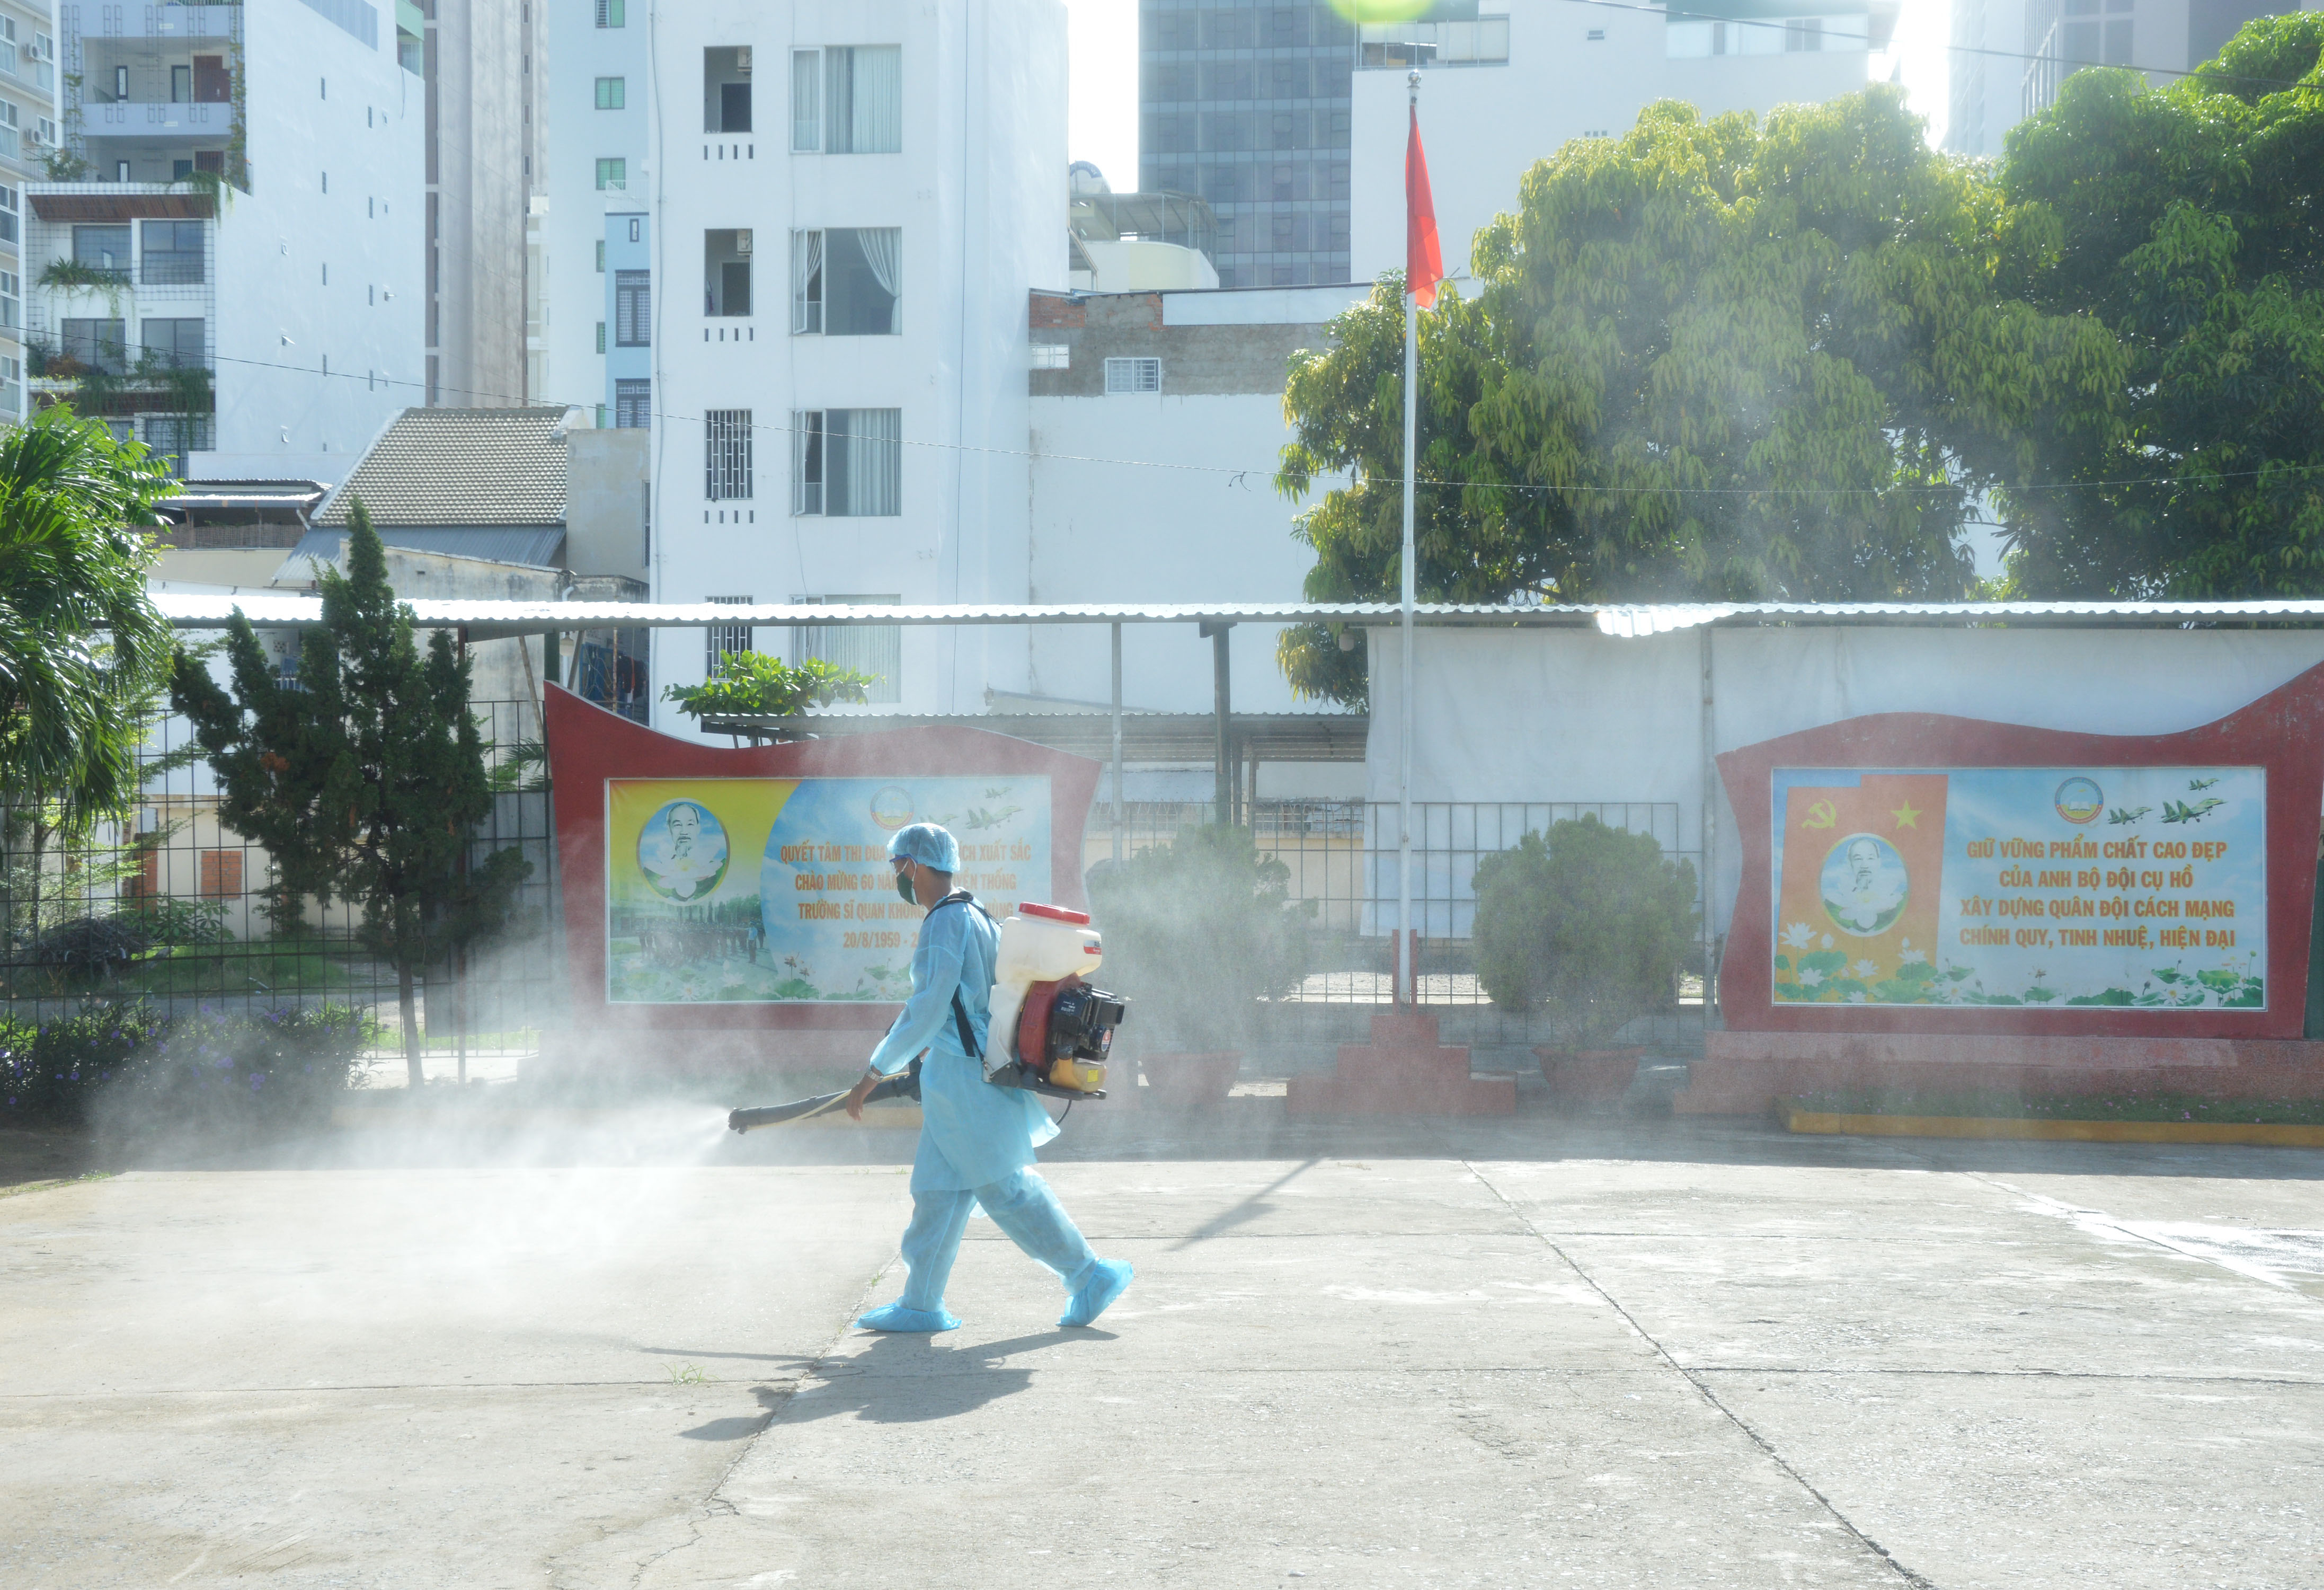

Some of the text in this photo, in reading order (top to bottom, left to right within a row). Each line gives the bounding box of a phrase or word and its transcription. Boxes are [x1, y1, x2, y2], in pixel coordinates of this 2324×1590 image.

[781, 837, 1031, 864] QUYẾT TÂM THI ĐUA ÍCH XUẤT SẮC
[1967, 833, 2228, 862] GIỮ VỮNG PHẨM CHẤT CAO ĐẸP
[795, 870, 824, 890] CHÀO
[827, 870, 858, 890] MỪNG
[861, 874, 874, 890] 60
[980, 867, 1017, 890] THỐNG
[1999, 864, 2193, 891] CỦA ANH BỘ ĐỘI CỤ HỒ
[798, 898, 841, 920] TRƯỜNG
[844, 899, 855, 920] SĨ
[857, 903, 885, 922] QUAN
[1961, 895, 2234, 921] XÂY DỰNG QUÂN ĐỘI CÁCH MẠNG
[843, 931, 901, 949] 20/8/1959
[1960, 924, 2236, 950] CHÍNH QUY, TINH NHUỆ, HIỆN ĐẠI
